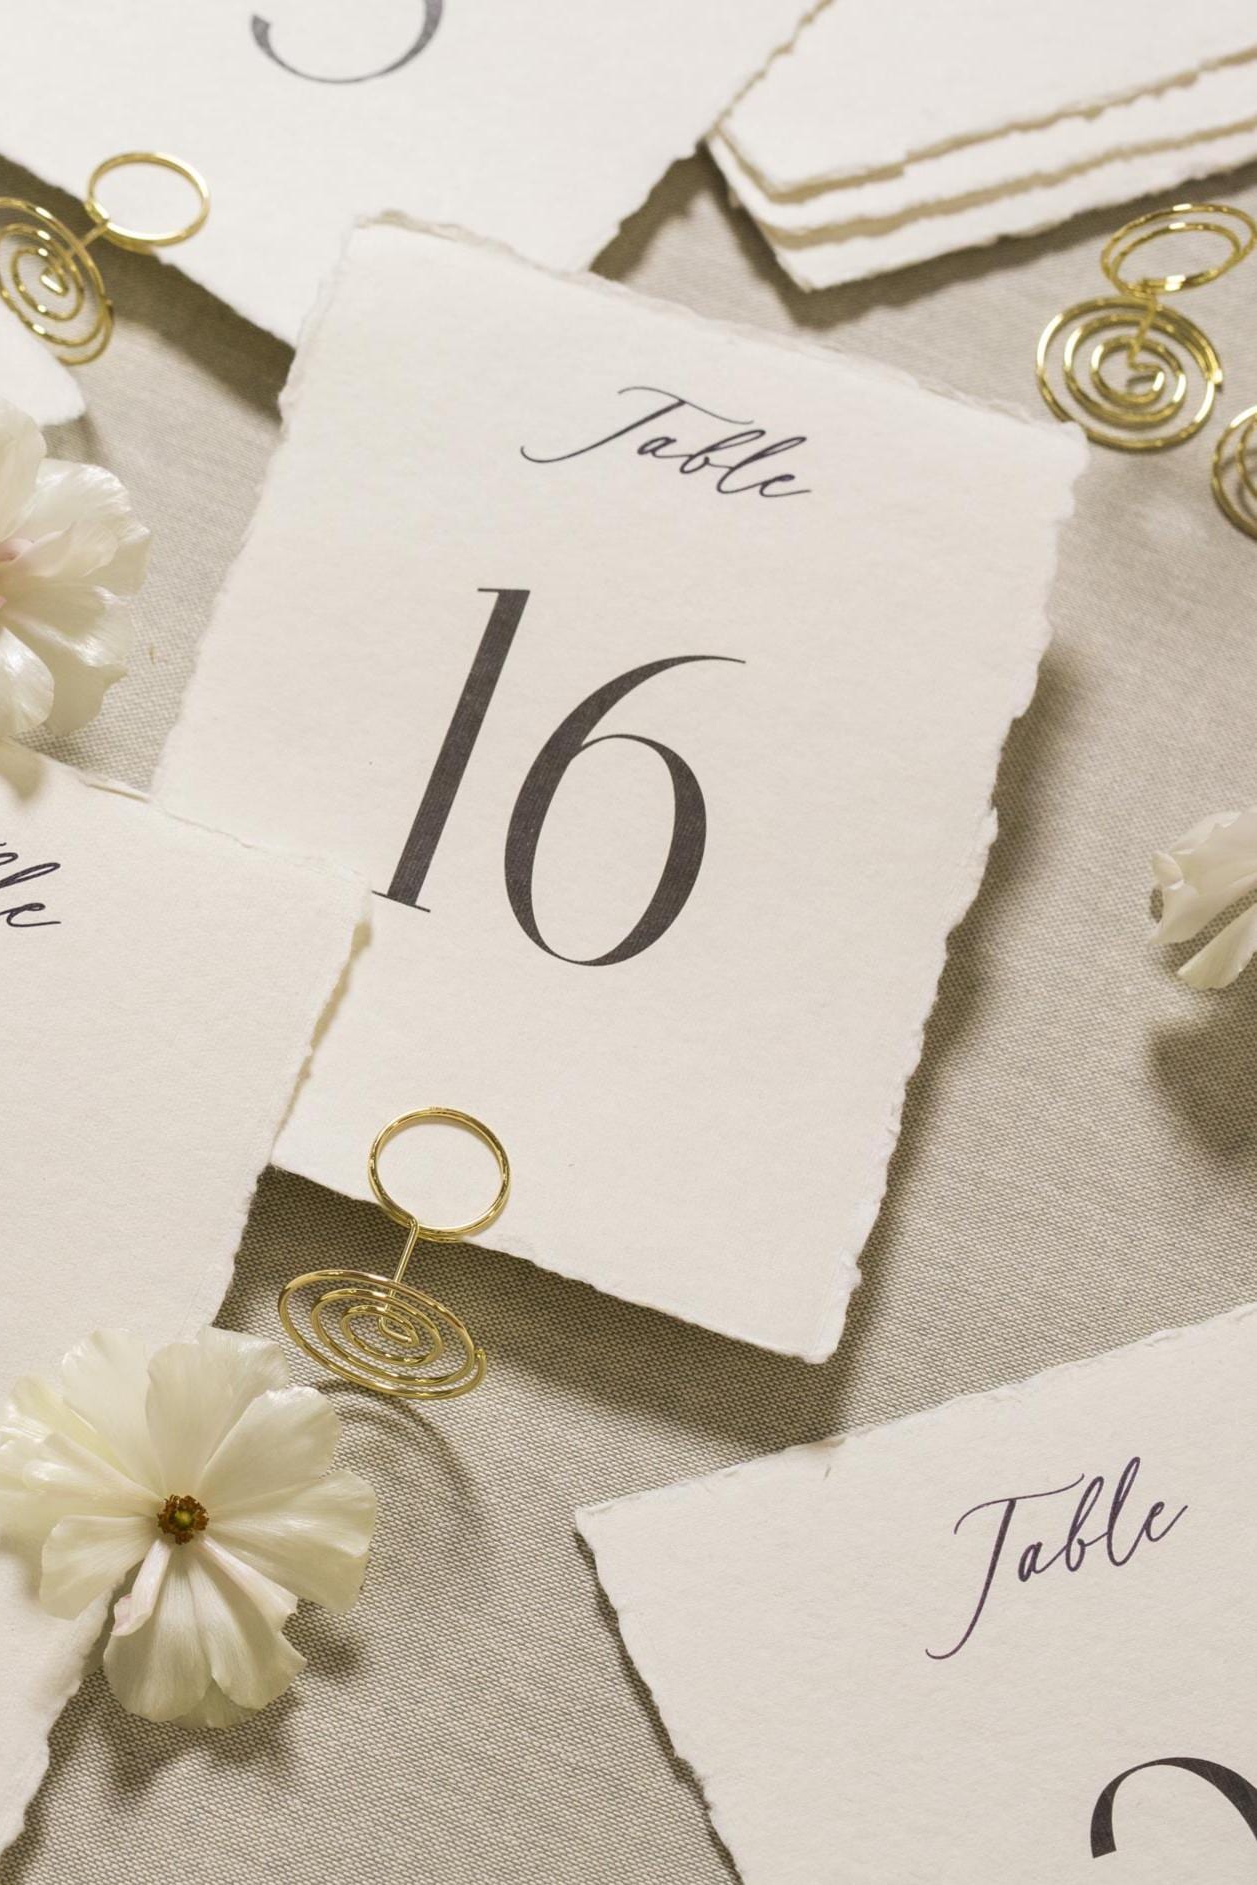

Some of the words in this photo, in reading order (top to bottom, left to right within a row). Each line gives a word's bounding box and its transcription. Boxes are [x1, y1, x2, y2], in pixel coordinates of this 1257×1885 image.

[520, 386, 812, 499] Table
[371, 587, 747, 967] 16
[924, 1456, 1189, 1661] Table
